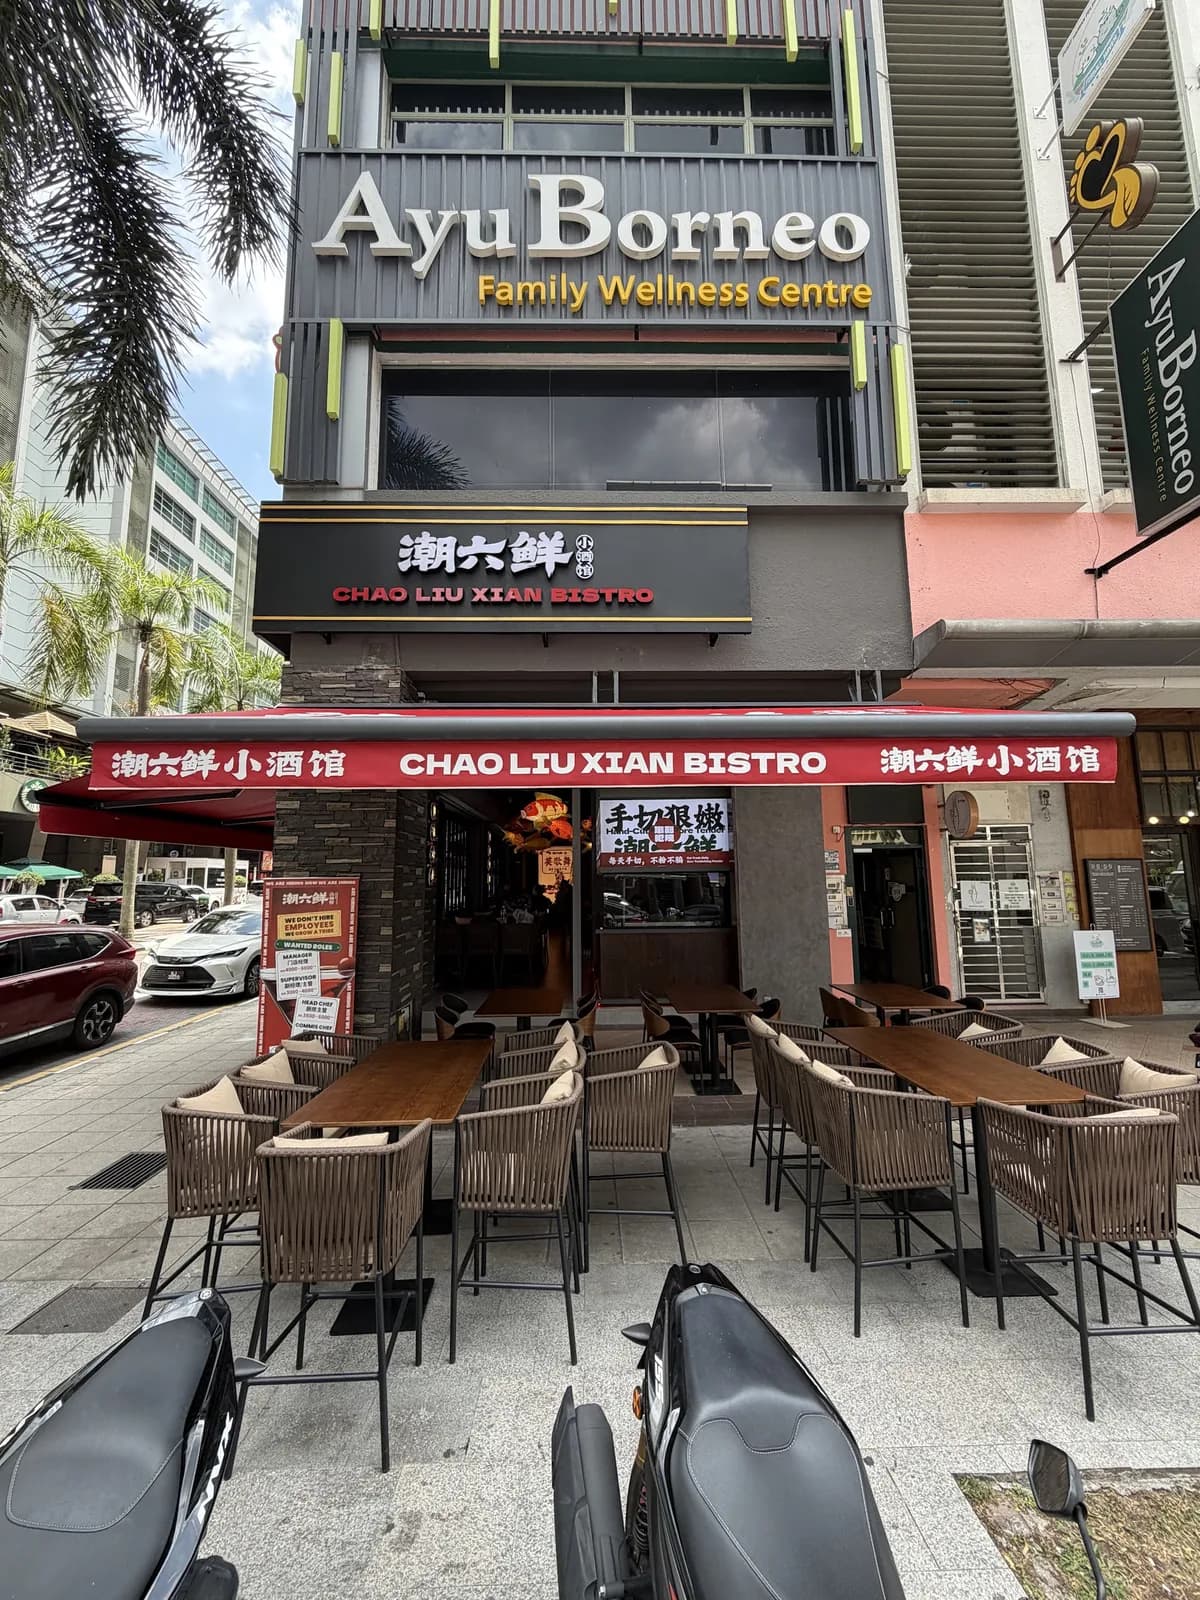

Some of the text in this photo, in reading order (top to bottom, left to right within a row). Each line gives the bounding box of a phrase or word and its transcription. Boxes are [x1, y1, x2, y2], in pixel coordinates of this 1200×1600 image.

[311, 171, 870, 279] Ayu Borneo
[478, 272, 872, 312] Family Wellness Centre
[1145, 257, 1197, 495] Ayu Borneo
[1140, 347, 1168, 502] Family Wellness Centre
[398, 531, 574, 579] 潮六鲜
[332, 587, 654, 605] CHAO LIU XIAN BISTRO
[400, 752, 827, 776] CHAO LIU XIAN BISTRO
[284, 921, 335, 931] EMPLOYEES
[283, 952, 313, 960] MANAGER
[280, 974, 317, 983] SUPERVISOR
